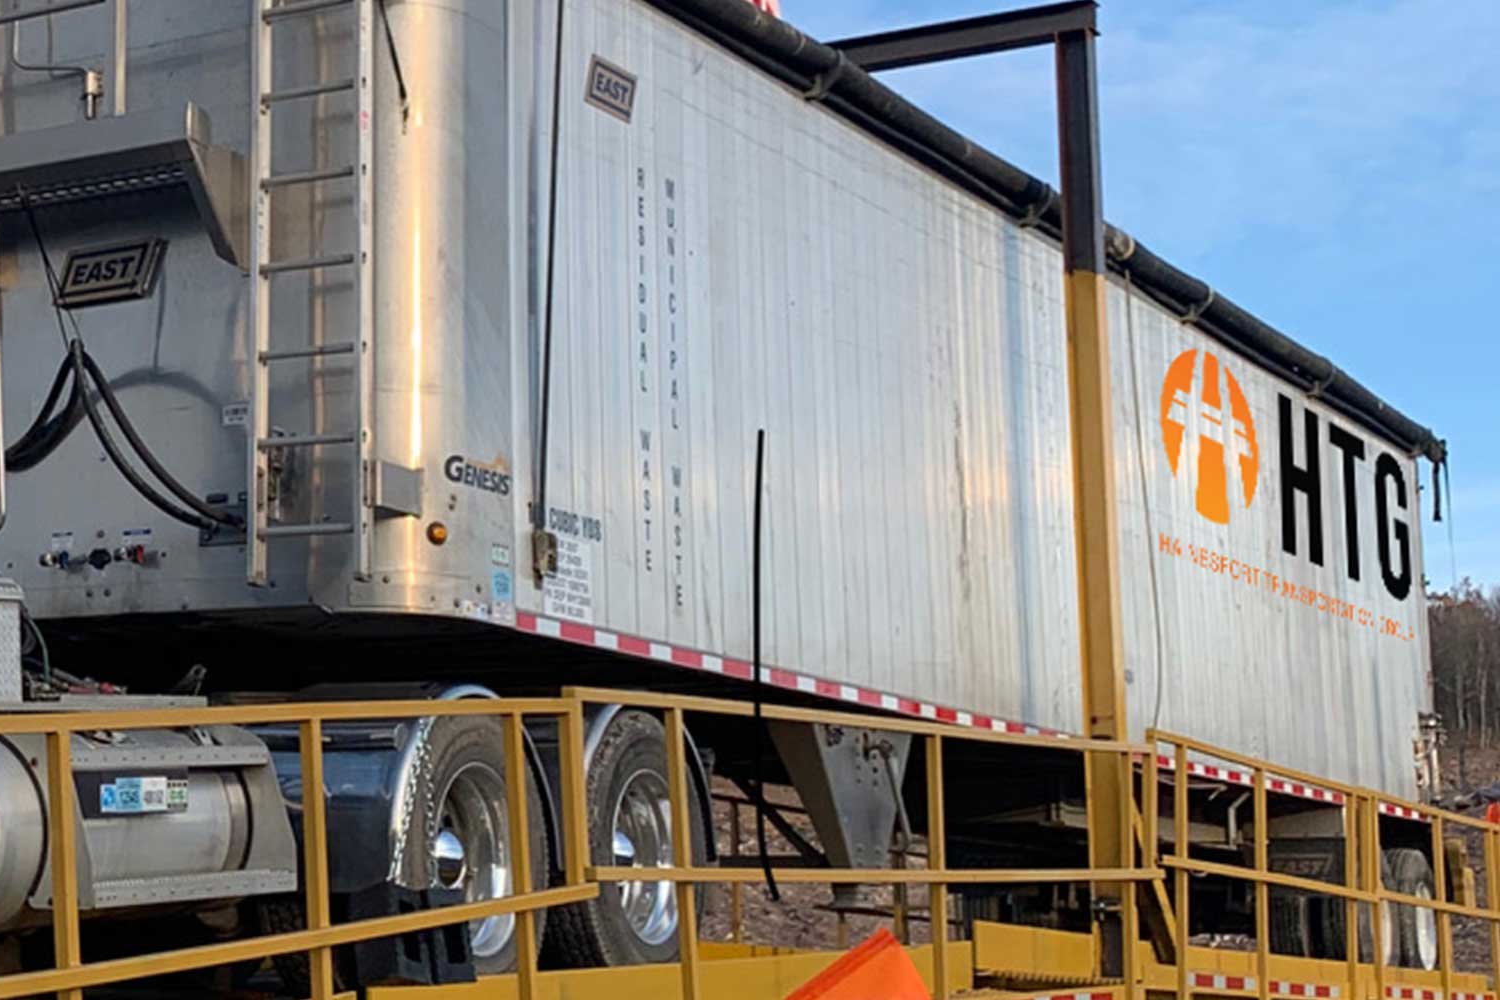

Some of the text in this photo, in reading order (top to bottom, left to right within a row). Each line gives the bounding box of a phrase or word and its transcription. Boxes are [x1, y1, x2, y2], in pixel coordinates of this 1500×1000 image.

[595, 71, 629, 104] EAST
[71, 255, 136, 287] EAST
[664, 178, 684, 607] MUNICIPAL WASTE
[549, 506, 579, 537] CUBIC
[640, 430, 652, 572] WASTE
[1277, 391, 1413, 602] HTG
